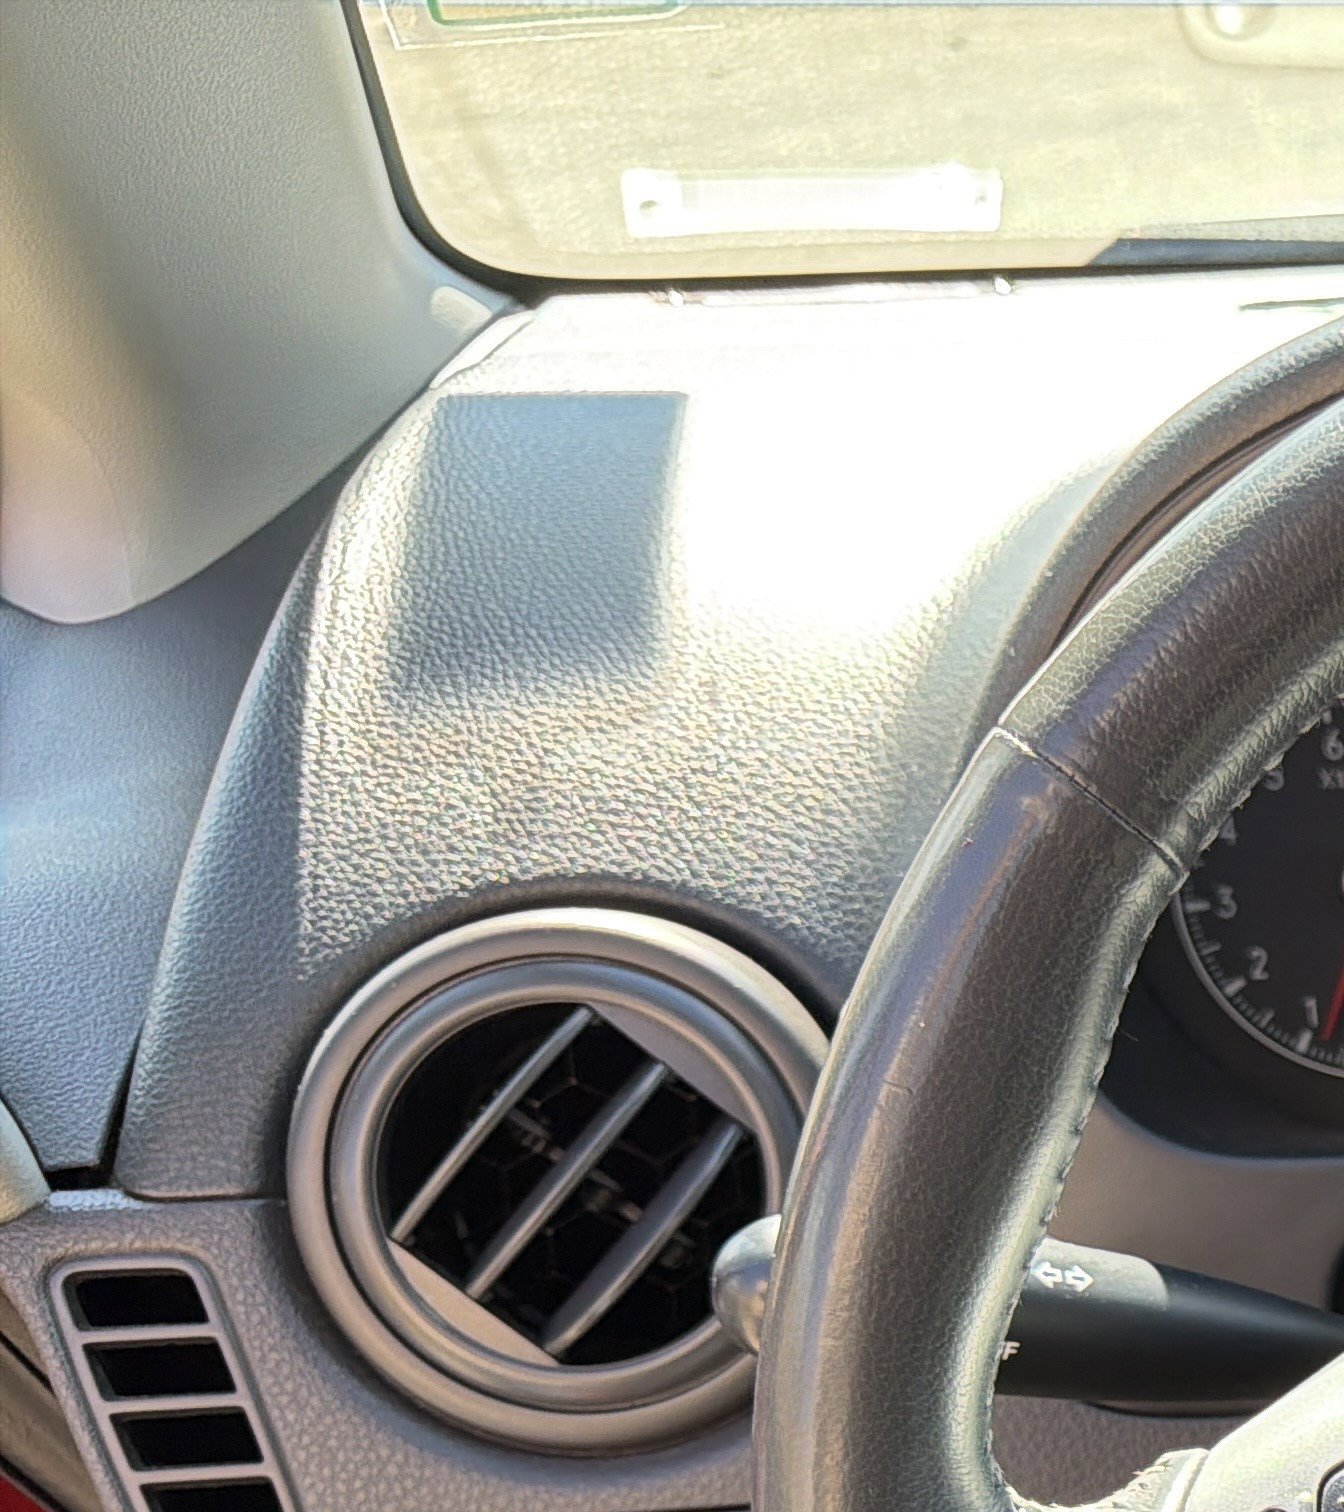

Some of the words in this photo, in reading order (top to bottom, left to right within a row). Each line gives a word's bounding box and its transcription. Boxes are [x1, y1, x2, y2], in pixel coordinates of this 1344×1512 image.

[1320, 727, 1344, 761] 6
[1211, 885, 1237, 919] 3
[1246, 946, 1269, 980] 2
[1304, 996, 1319, 1030] 1
